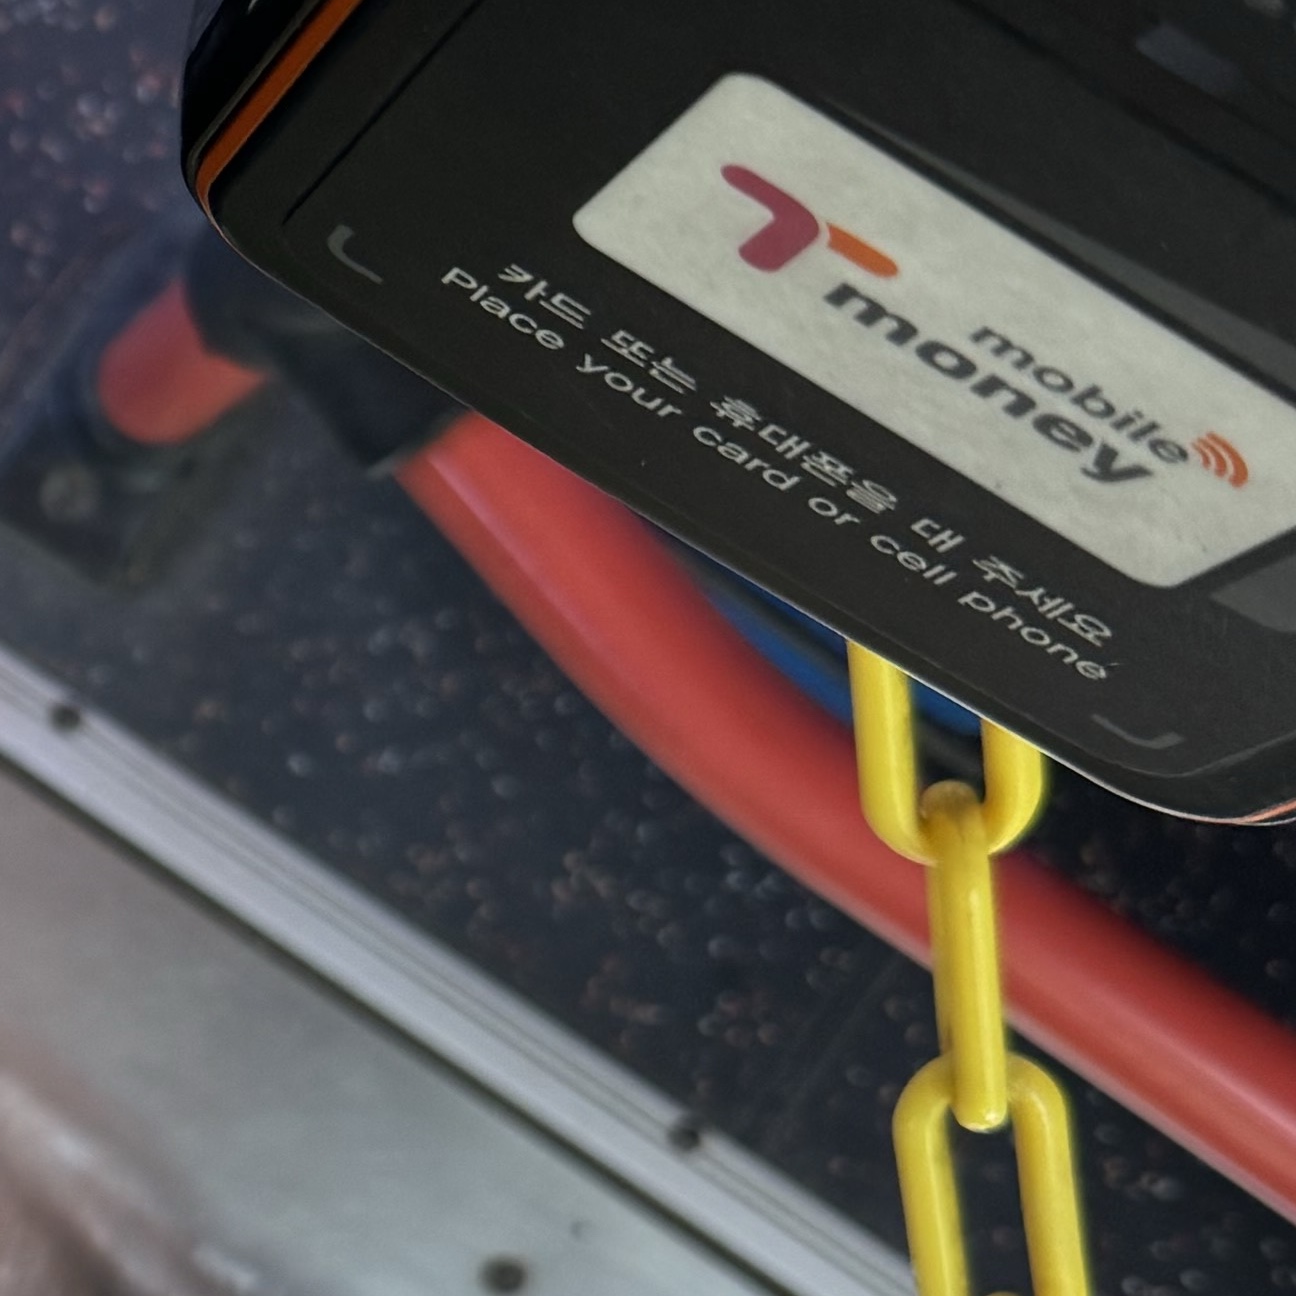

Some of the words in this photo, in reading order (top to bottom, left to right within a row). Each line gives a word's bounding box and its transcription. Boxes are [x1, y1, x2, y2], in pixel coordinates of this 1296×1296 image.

[440, 266, 565, 350] Place
[575, 352, 683, 418] your
[692, 425, 802, 491] card
[807, 496, 862, 527] or
[869, 534, 958, 586] cell
[956, 590, 1108, 682] phone
[497, 263, 592, 330] 카드
[600, 329, 697, 394] 또는
[709, 395, 898, 514] 휴대폰을
[910, 517, 966, 553] 대
[971, 555, 1113, 647] 주세요
[823, 281, 1157, 484] money
[970, 325, 1190, 464] mobile
